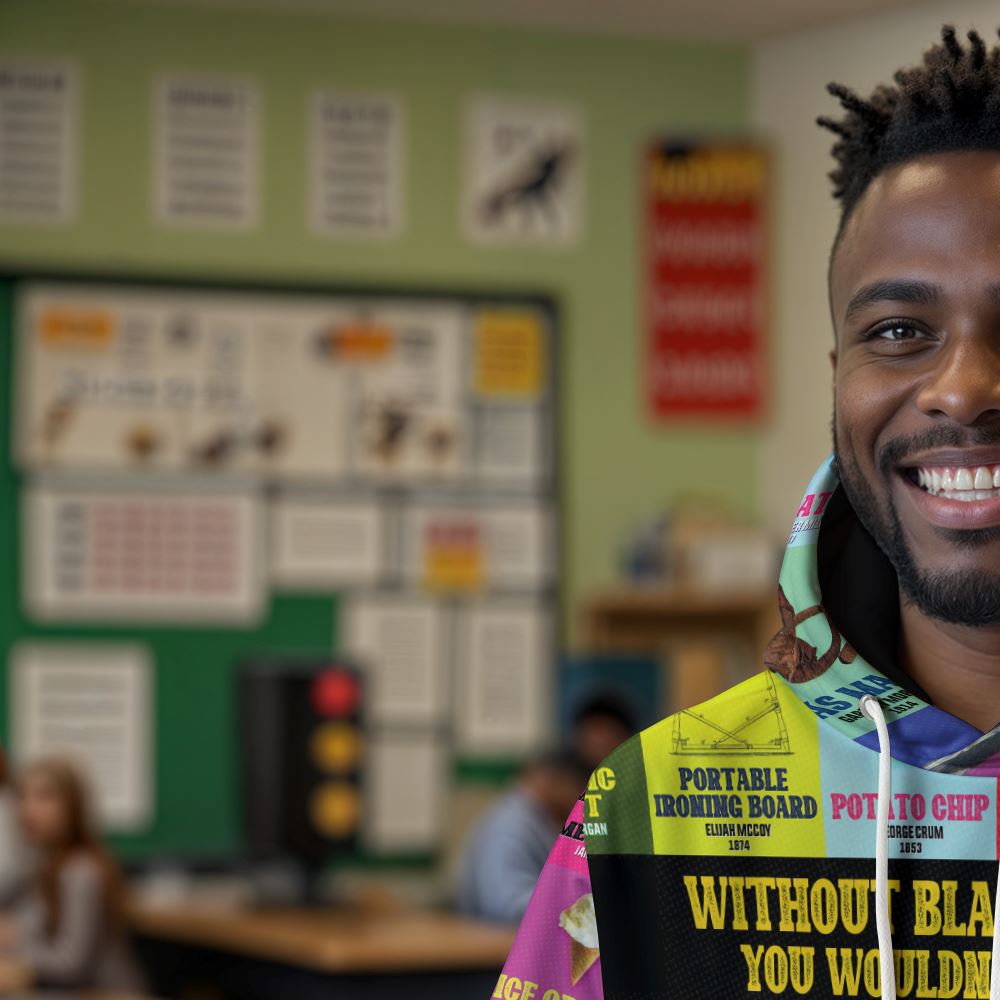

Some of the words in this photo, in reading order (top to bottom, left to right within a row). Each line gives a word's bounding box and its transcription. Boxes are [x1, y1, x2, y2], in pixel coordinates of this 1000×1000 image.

[680, 768, 788, 792] PORTABLE
[654, 794, 743, 819] IRONING
[748, 795, 818, 819] BOARD
[931, 793, 990, 821] CHIP
[705, 823, 736, 837] ELIJAH
[739, 824, 772, 838] MCCOY
[916, 825, 944, 840] CRUM
[728, 839, 751, 851] 1874
[899, 842, 923, 854] 1853
[683, 875, 900, 935] WITHOUT
[740, 943, 815, 995] YOU
